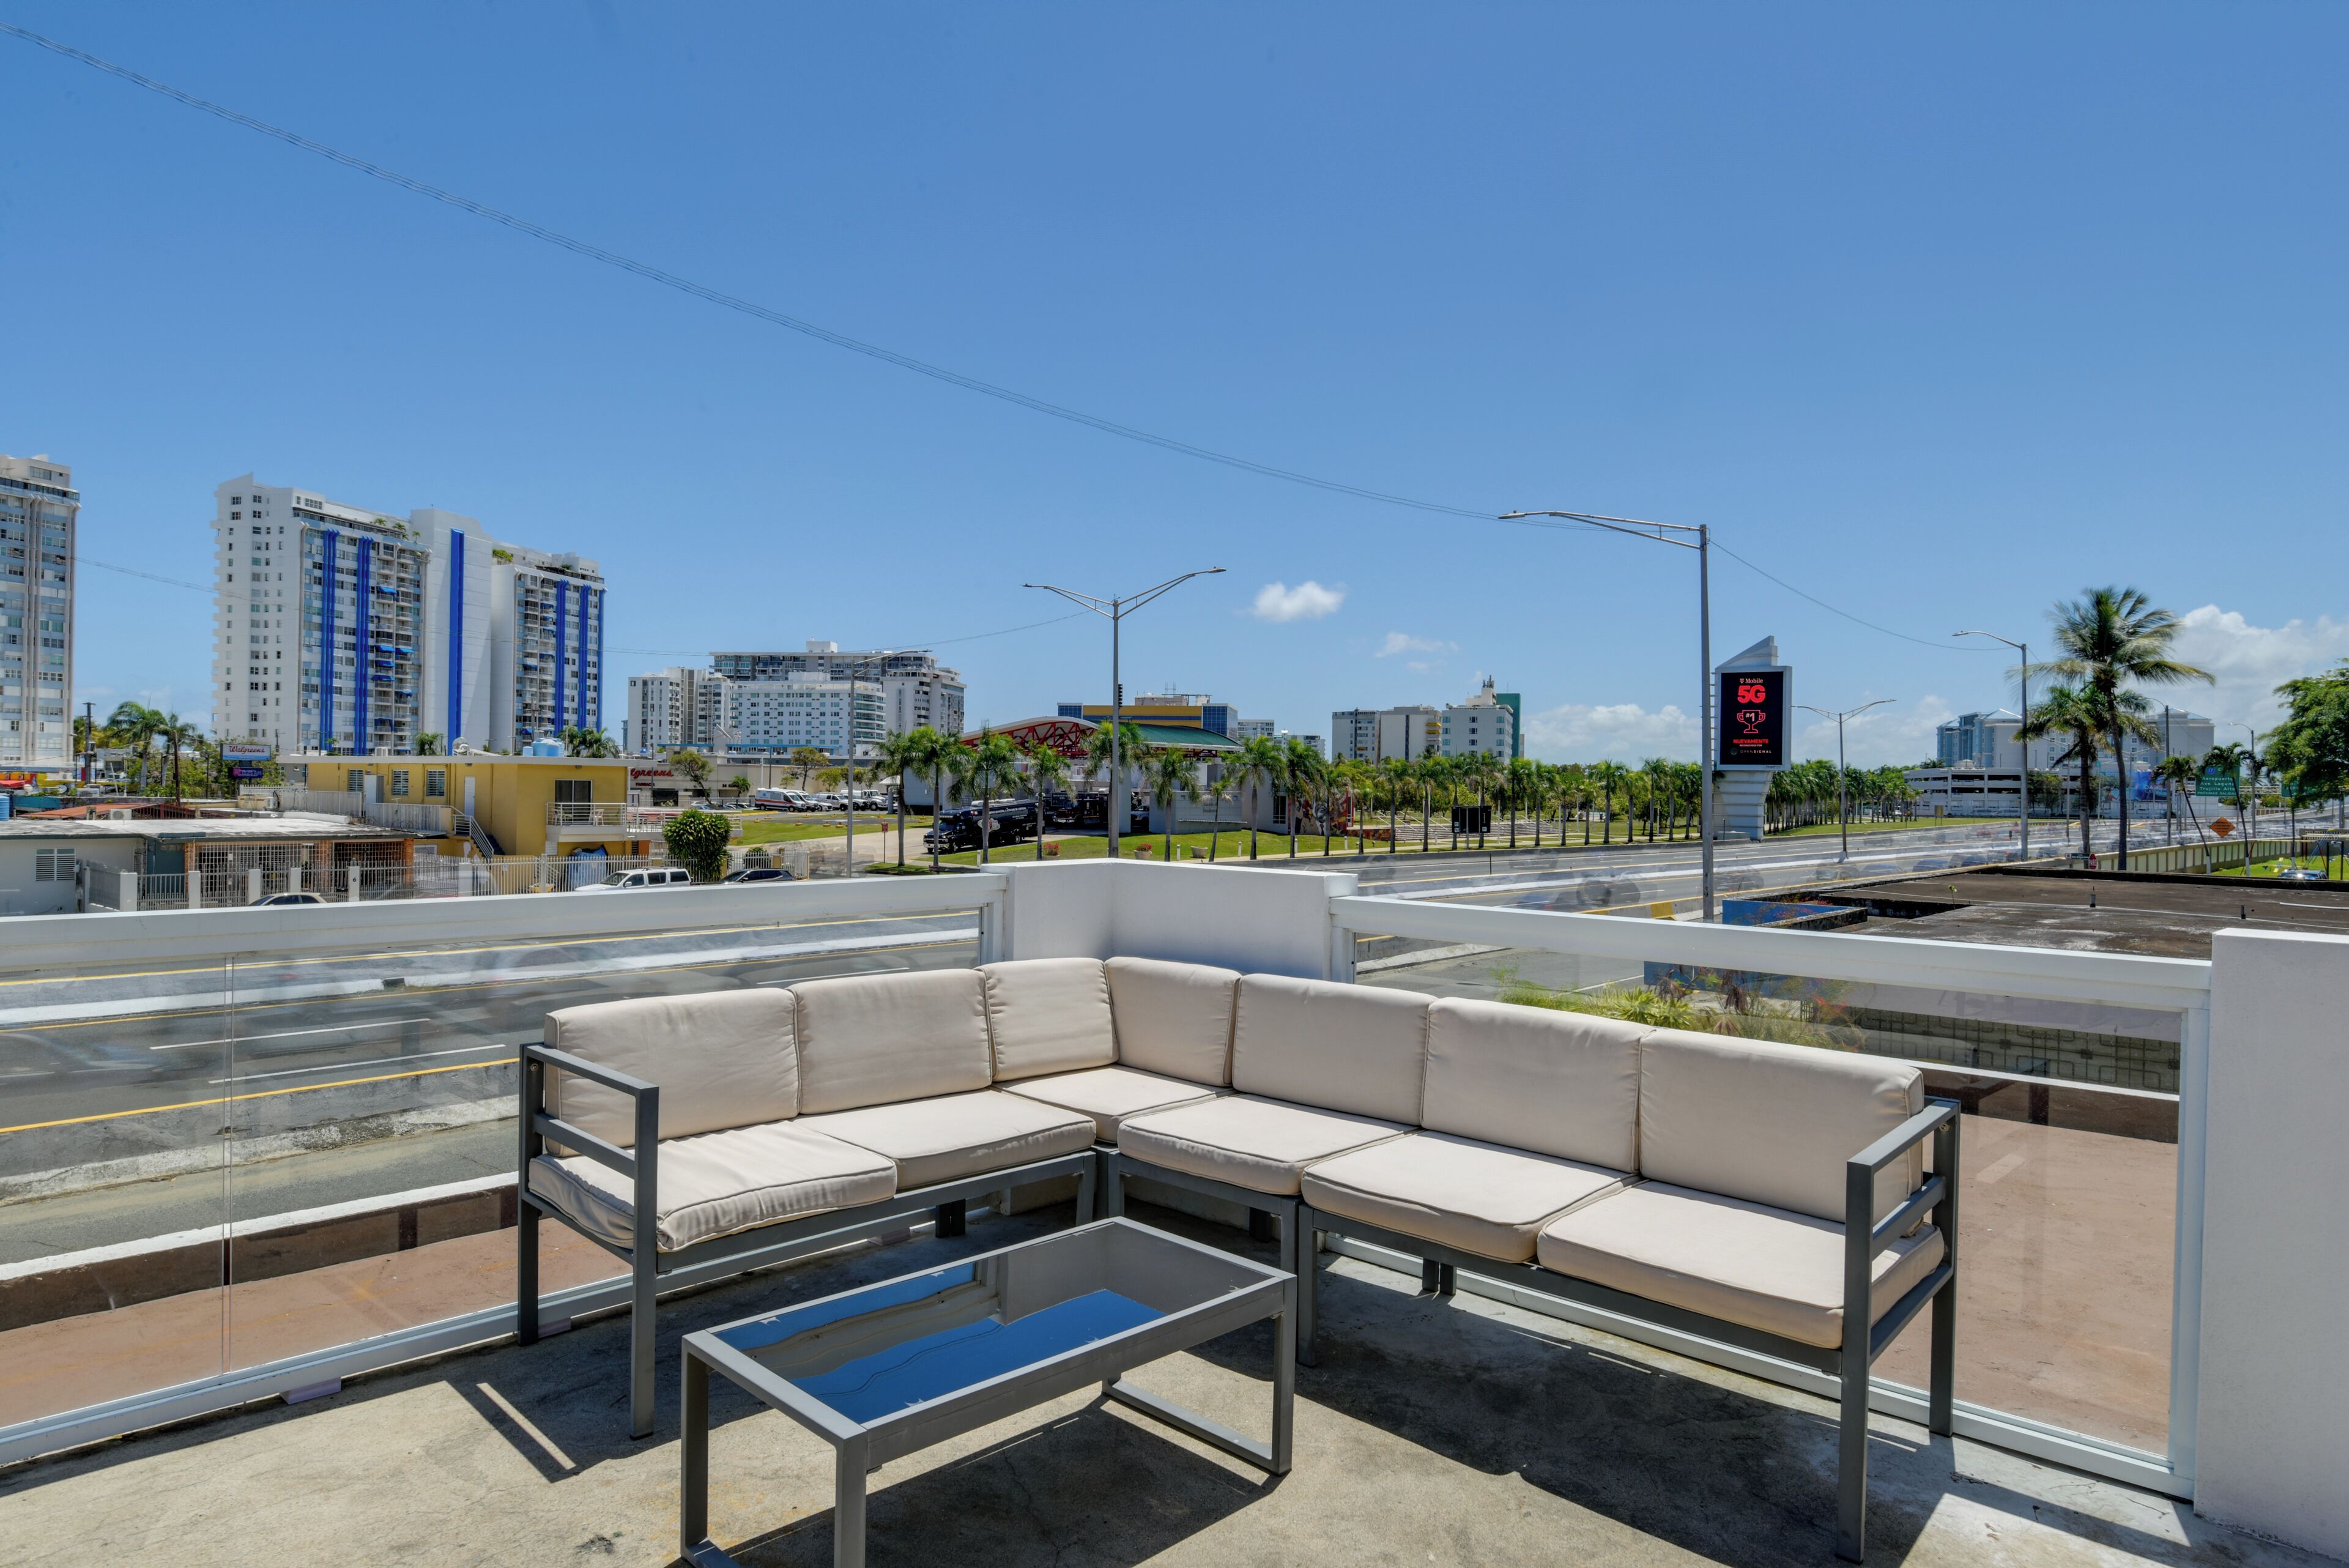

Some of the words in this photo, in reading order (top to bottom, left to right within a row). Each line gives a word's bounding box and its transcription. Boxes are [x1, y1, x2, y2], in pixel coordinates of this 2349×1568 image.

[1737, 685, 1766, 704] 5G
[1745, 712, 1755, 722] #1
[229, 745, 265, 754] Walgreens
[631, 768, 674, 779] lgreens
